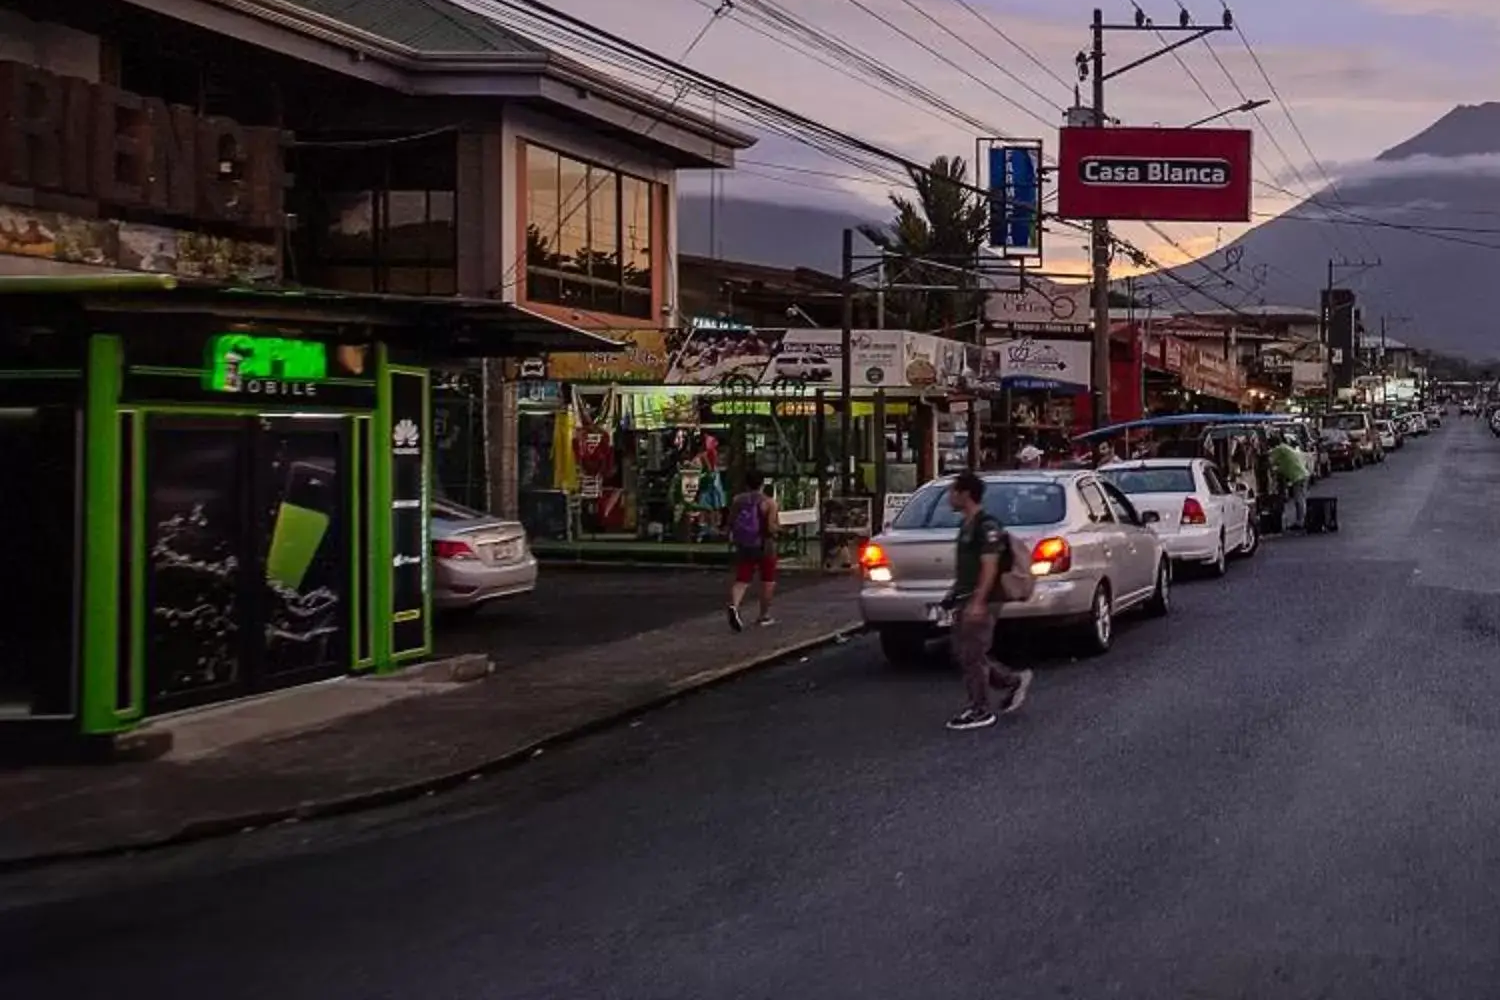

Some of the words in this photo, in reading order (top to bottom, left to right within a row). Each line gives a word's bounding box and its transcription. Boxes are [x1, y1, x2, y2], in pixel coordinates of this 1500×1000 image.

[1085, 161, 1140, 181] Casa
[1147, 162, 1226, 183] Blanca
[228, 379, 317, 396] OBILE
